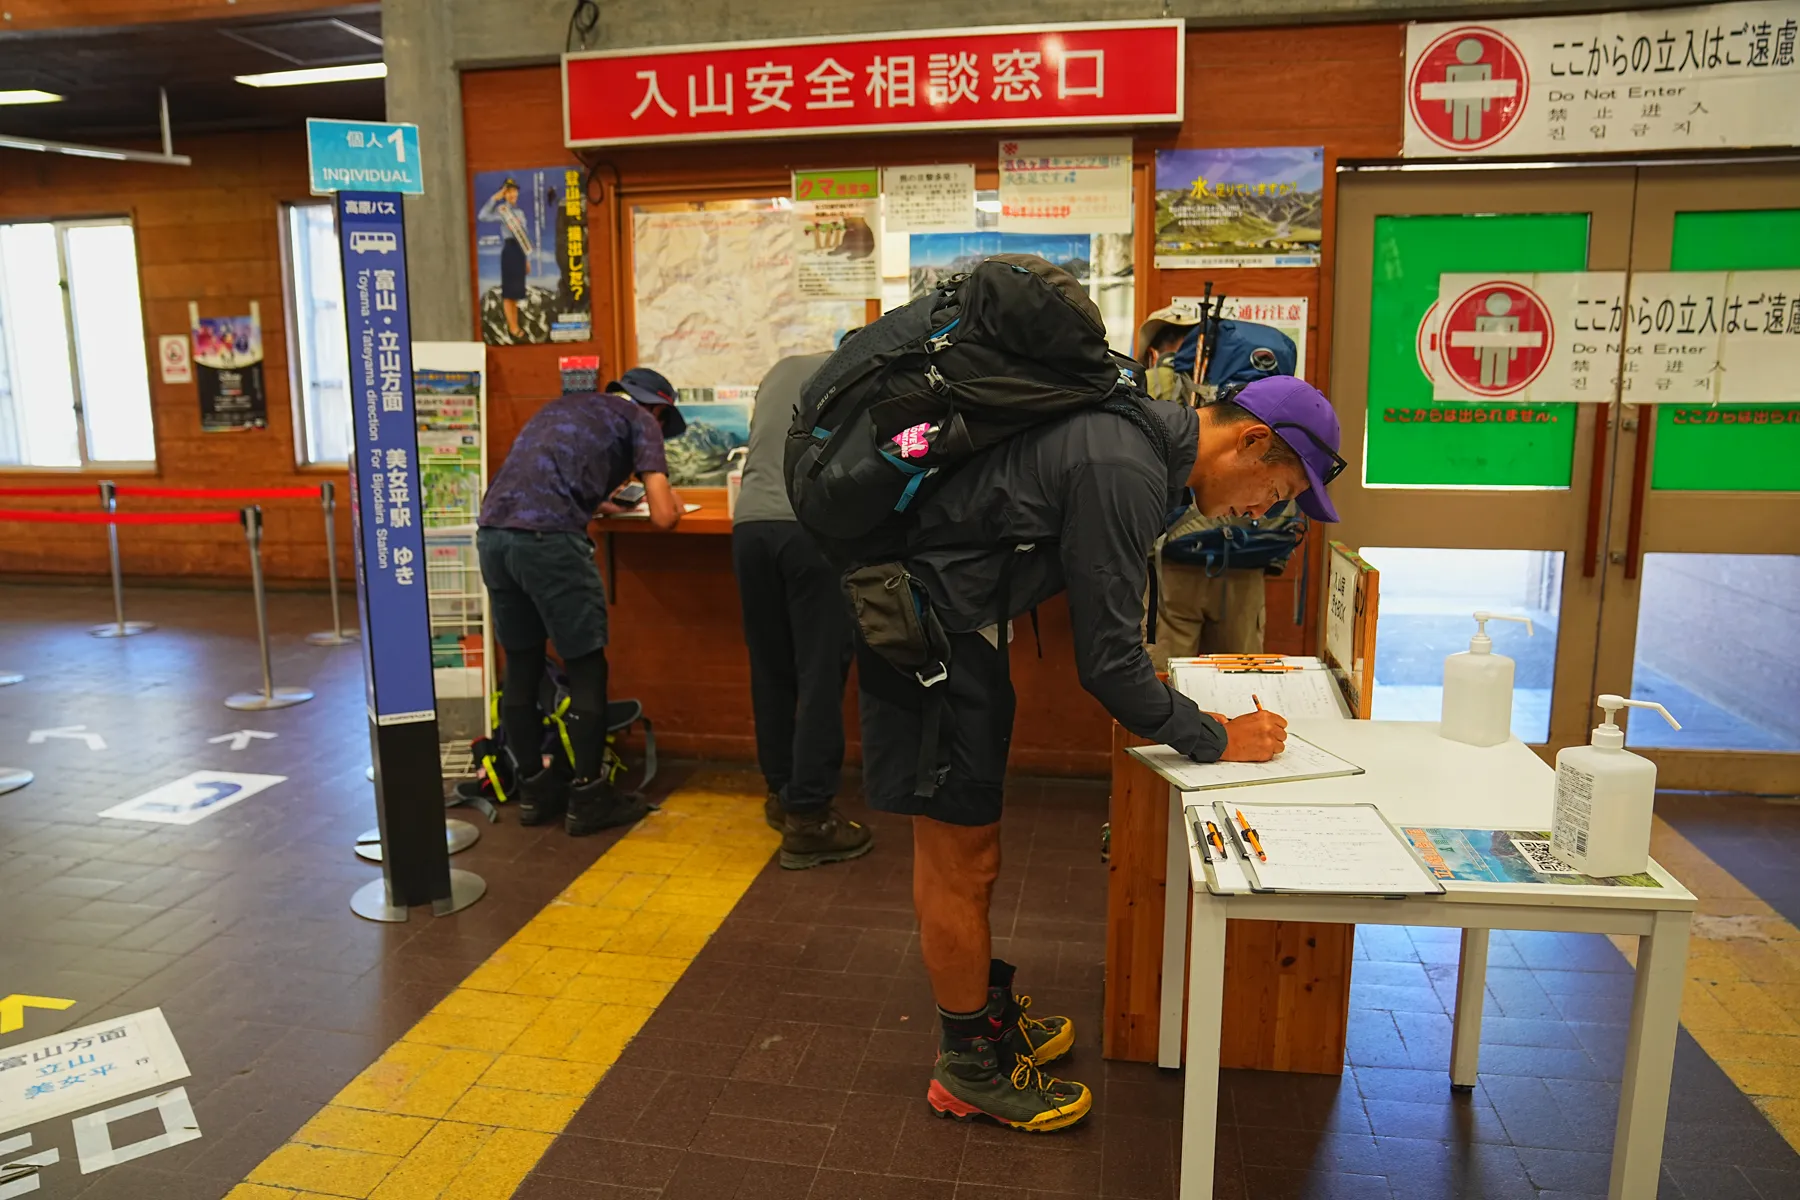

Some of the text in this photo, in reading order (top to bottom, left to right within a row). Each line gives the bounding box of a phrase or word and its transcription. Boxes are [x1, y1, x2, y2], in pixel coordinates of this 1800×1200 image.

[1550, 19, 1799, 77] ここからの立入はご遠慮
[630, 48, 1105, 120] 入山安全相談窓口
[1548, 86, 1686, 102] Do Not Enter
[346, 128, 406, 163] 個人 1
[322, 167, 412, 184] INDIVIDUAL
[345, 200, 397, 215] 高原バス
[1572, 343, 1708, 355] Do Not Enter
[366, 389, 380, 441] direction
[374, 269, 414, 585] 富山・立山方面 美女平駅 ゆき
[1383, 407, 1558, 423] ここからは出られません。
[371, 449, 382, 469] For
[370, 473, 386, 525] Bijodaira
[376, 528, 388, 569] Station
[23, 1062, 118, 1100] 美女平
[36, 1053, 96, 1079] 立山
